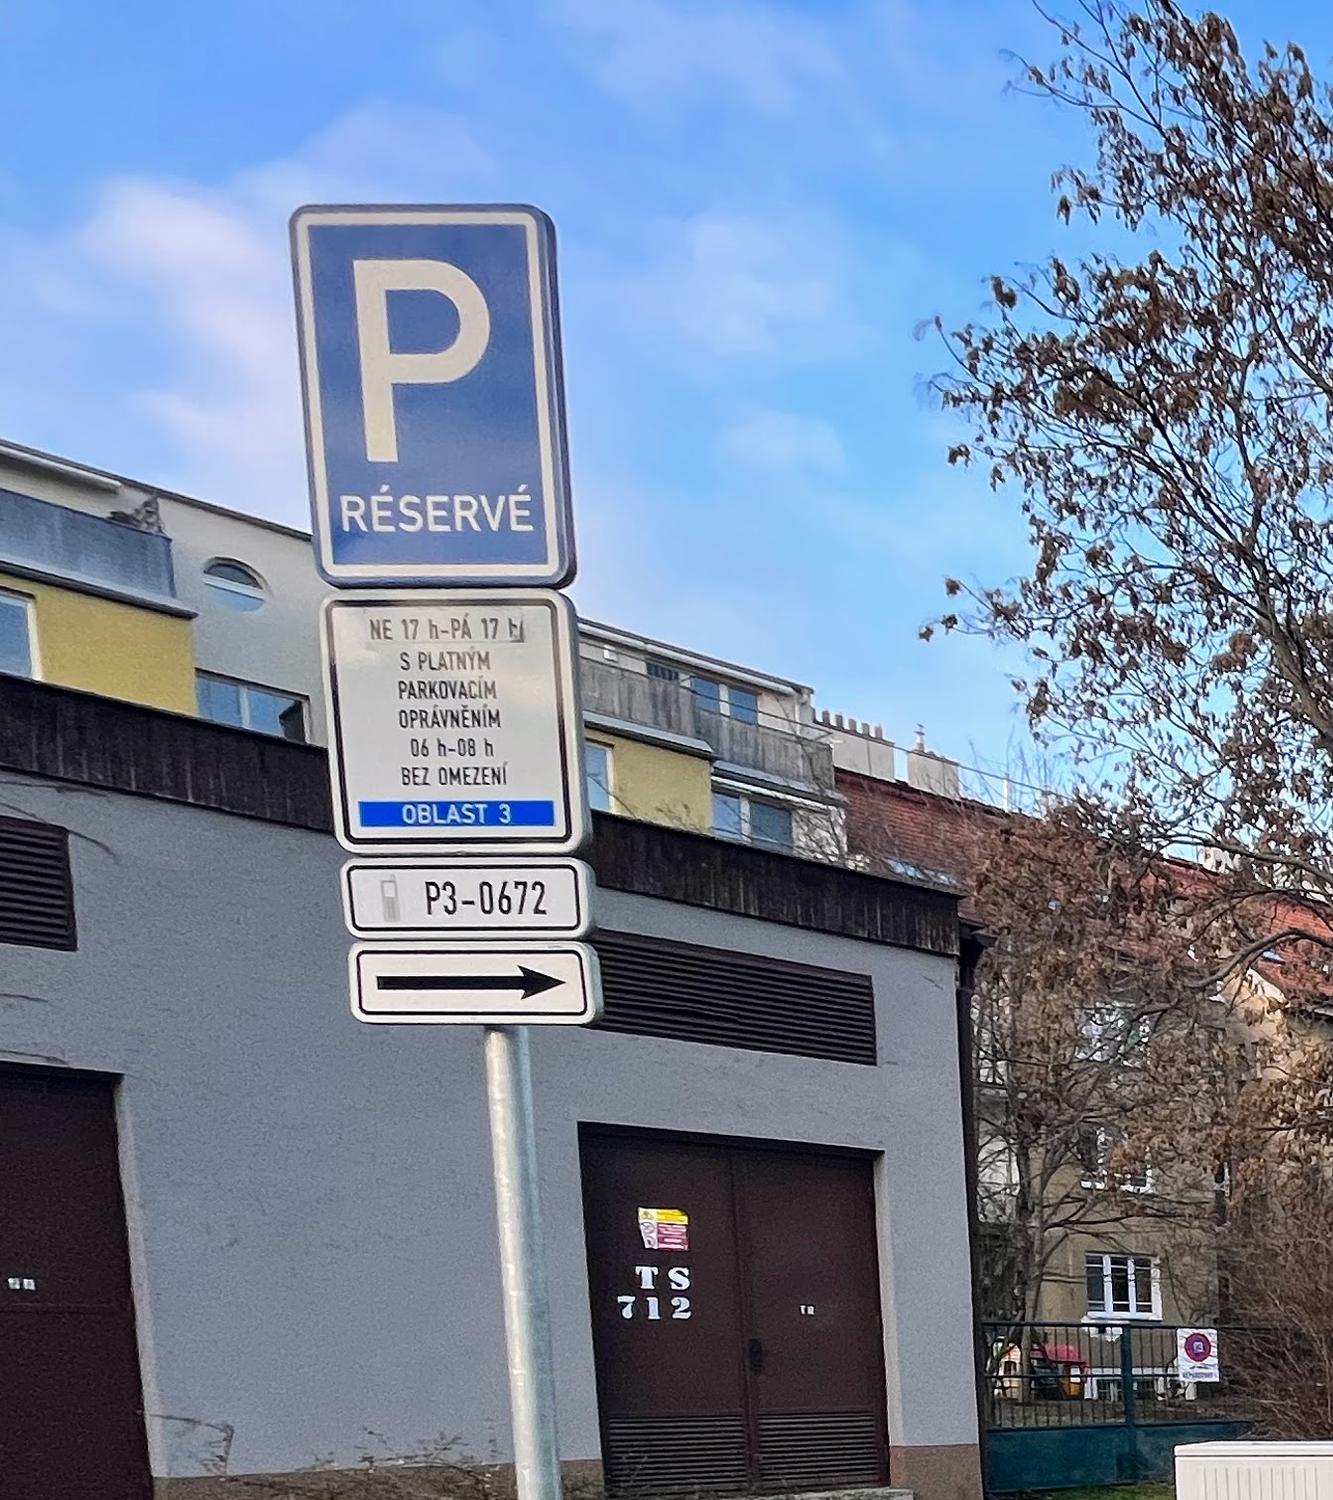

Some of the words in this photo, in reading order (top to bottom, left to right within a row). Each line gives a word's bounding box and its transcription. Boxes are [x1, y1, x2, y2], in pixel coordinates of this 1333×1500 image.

[352, 259, 490, 463] P
[339, 484, 535, 533] RÉSERVÉ
[369, 617, 393, 640] NE
[401, 618, 419, 640] 17
[481, 617, 499, 639] 17
[399, 651, 411, 671] S
[418, 645, 491, 671] PLATNÝM
[398, 675, 497, 700] PARKOVACÍM
[399, 703, 501, 729] OPRÁVNĚNÍM
[410, 738, 430, 757] 06
[484, 738, 494, 757] h
[401, 766, 430, 786] BEZ
[438, 761, 508, 786] OMEZENÍ
[402, 803, 488, 825] OBLAST
[499, 803, 512, 824] 3
[424, 880, 548, 916] P3-0672
[635, 1265, 692, 1290] TS
[617, 1296, 692, 1320] 712
